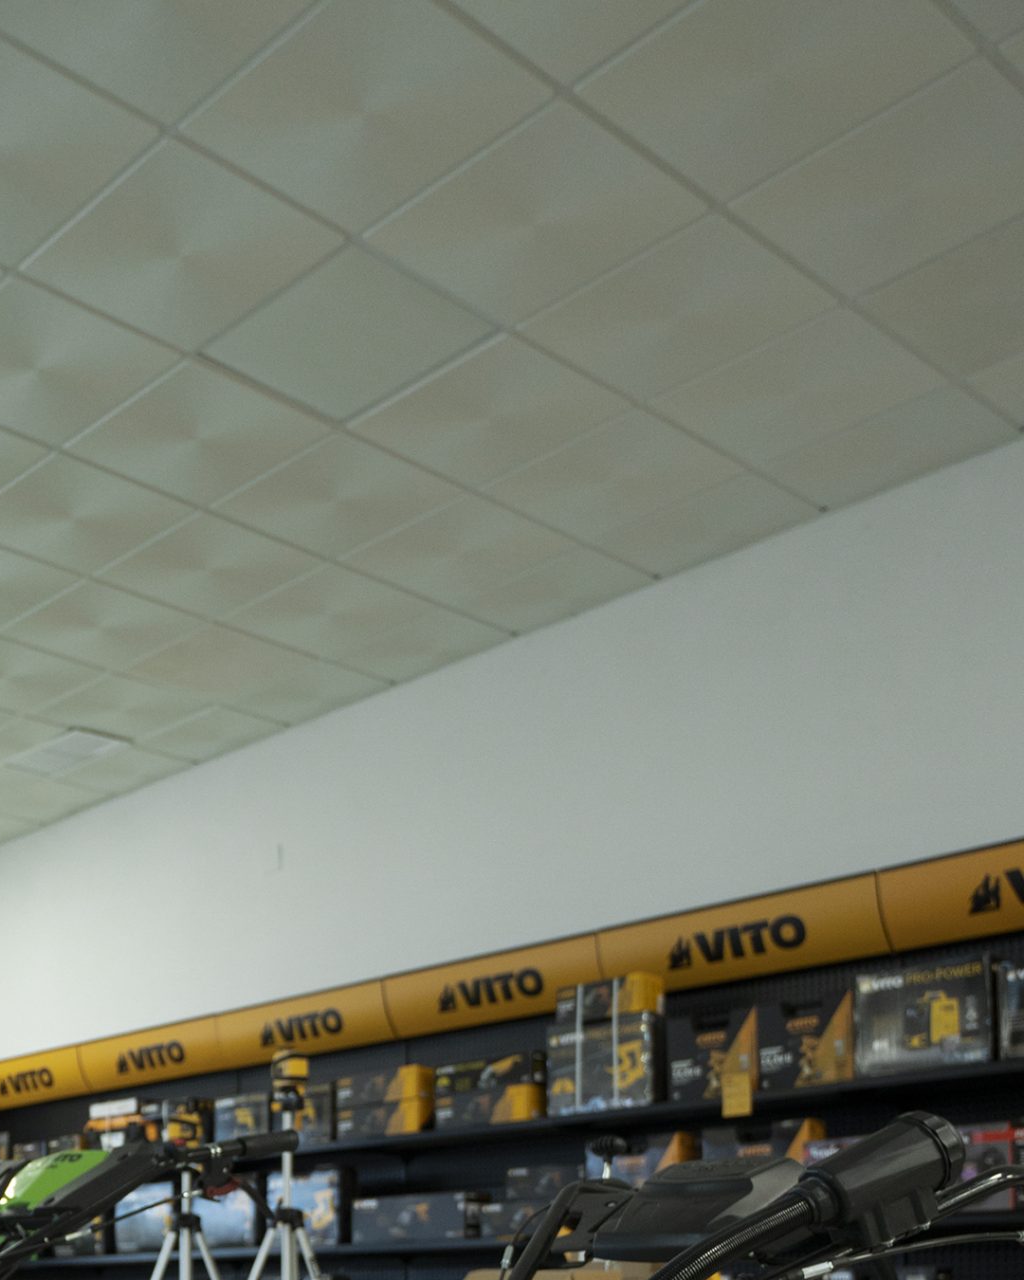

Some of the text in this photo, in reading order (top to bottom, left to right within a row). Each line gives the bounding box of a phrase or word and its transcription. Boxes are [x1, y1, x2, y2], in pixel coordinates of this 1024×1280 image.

[693, 915, 807, 963] VITO
[458, 968, 543, 1007] VITO
[276, 1008, 343, 1043] VITO
[128, 1040, 185, 1070] VITO
[8, 1067, 54, 1095] VITO
